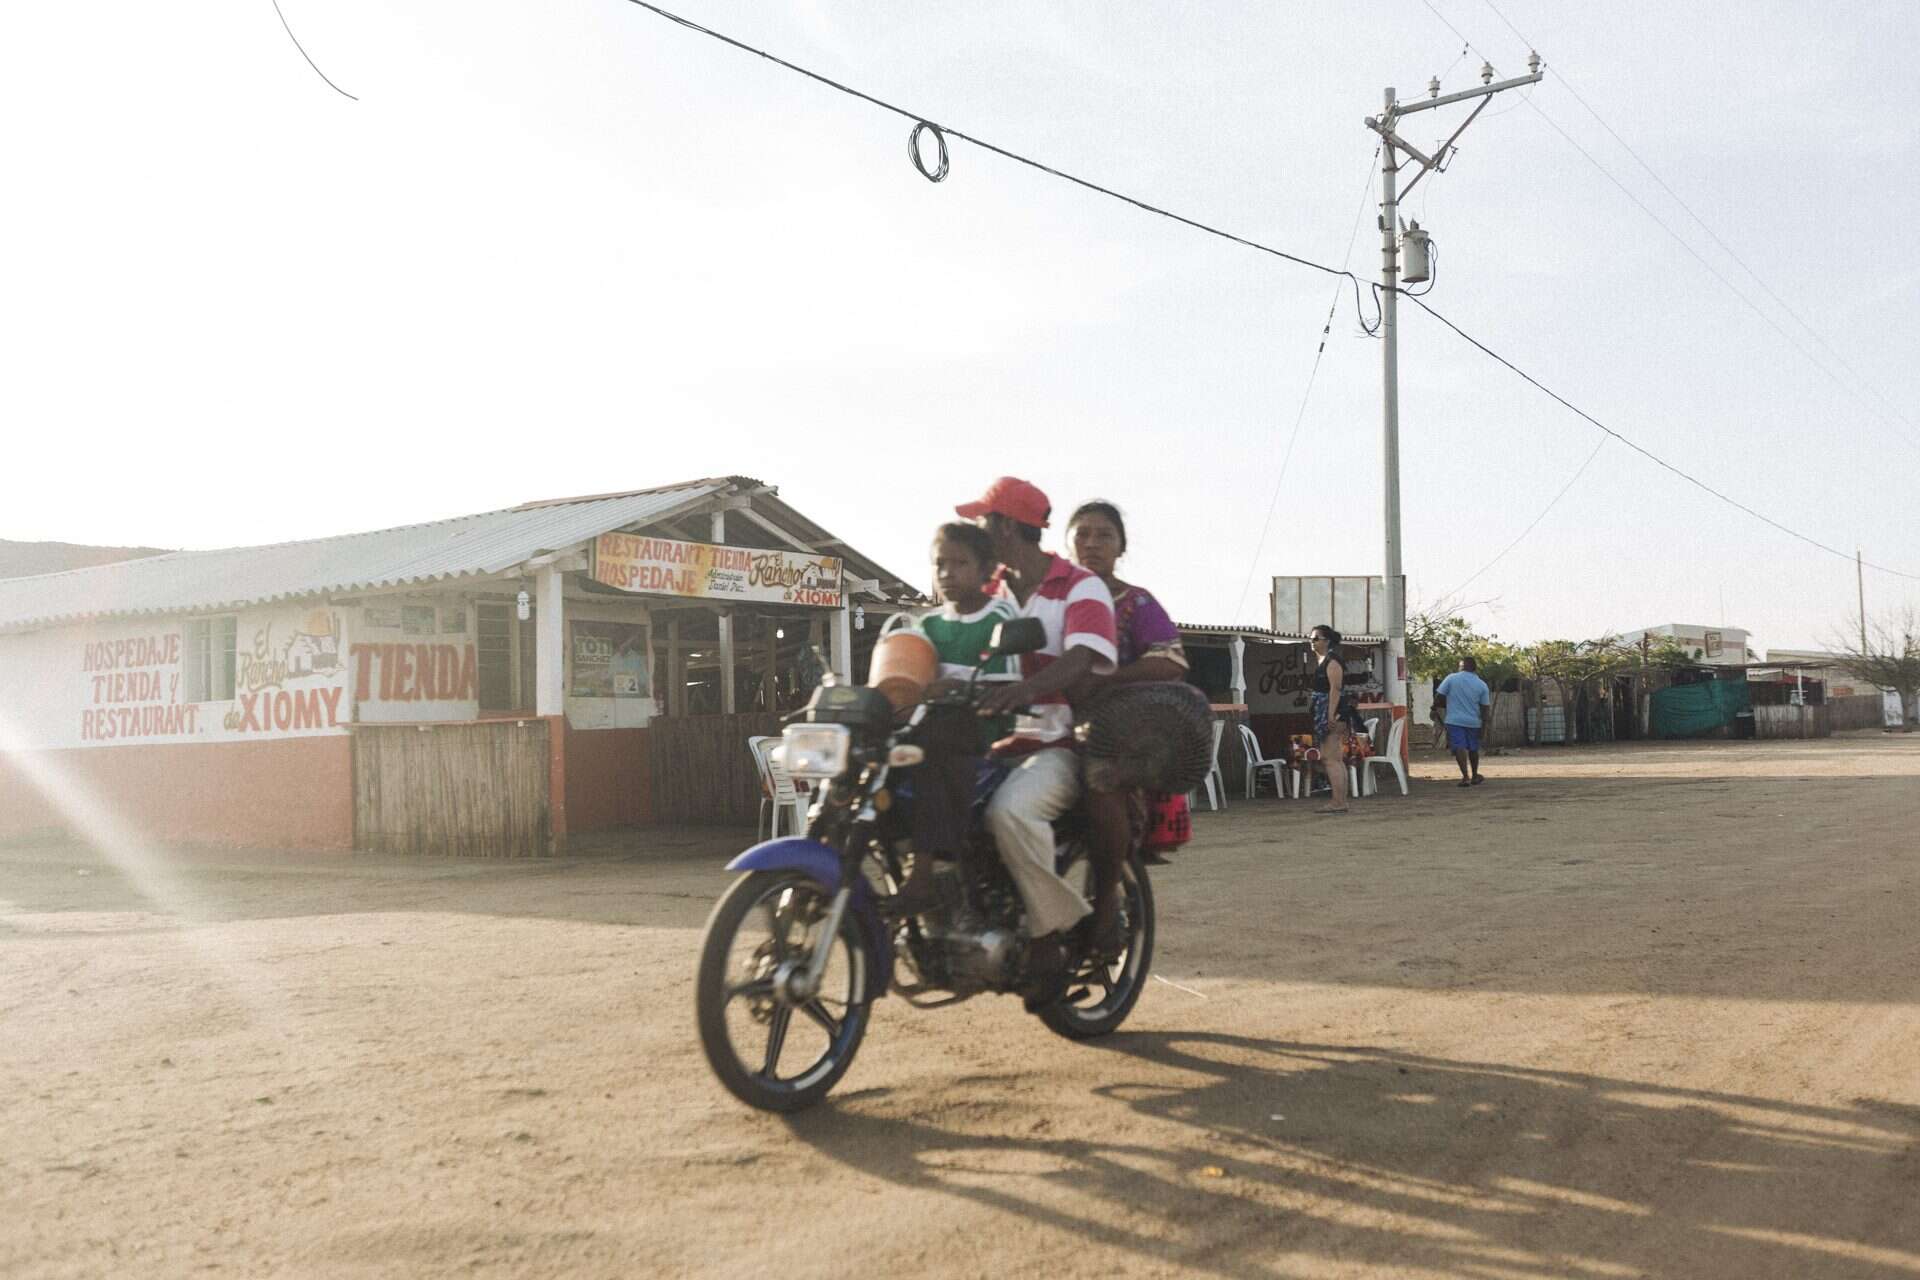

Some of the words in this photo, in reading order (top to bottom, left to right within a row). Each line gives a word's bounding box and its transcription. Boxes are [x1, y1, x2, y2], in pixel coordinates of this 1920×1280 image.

[709, 547, 752, 572] TIENDA
[749, 554, 801, 588] Rancho
[597, 561, 700, 593] HOSPEDAJE
[793, 589, 840, 606] XIOMY
[82, 633, 180, 672] HOSPEDAJE
[256, 621, 272, 660] El
[91, 671, 161, 704] TIENDA
[237, 648, 289, 693] Rancho
[349, 642, 480, 703] TIENDA
[628, 678, 638, 692] 2
[238, 687, 342, 733] XIOMY
